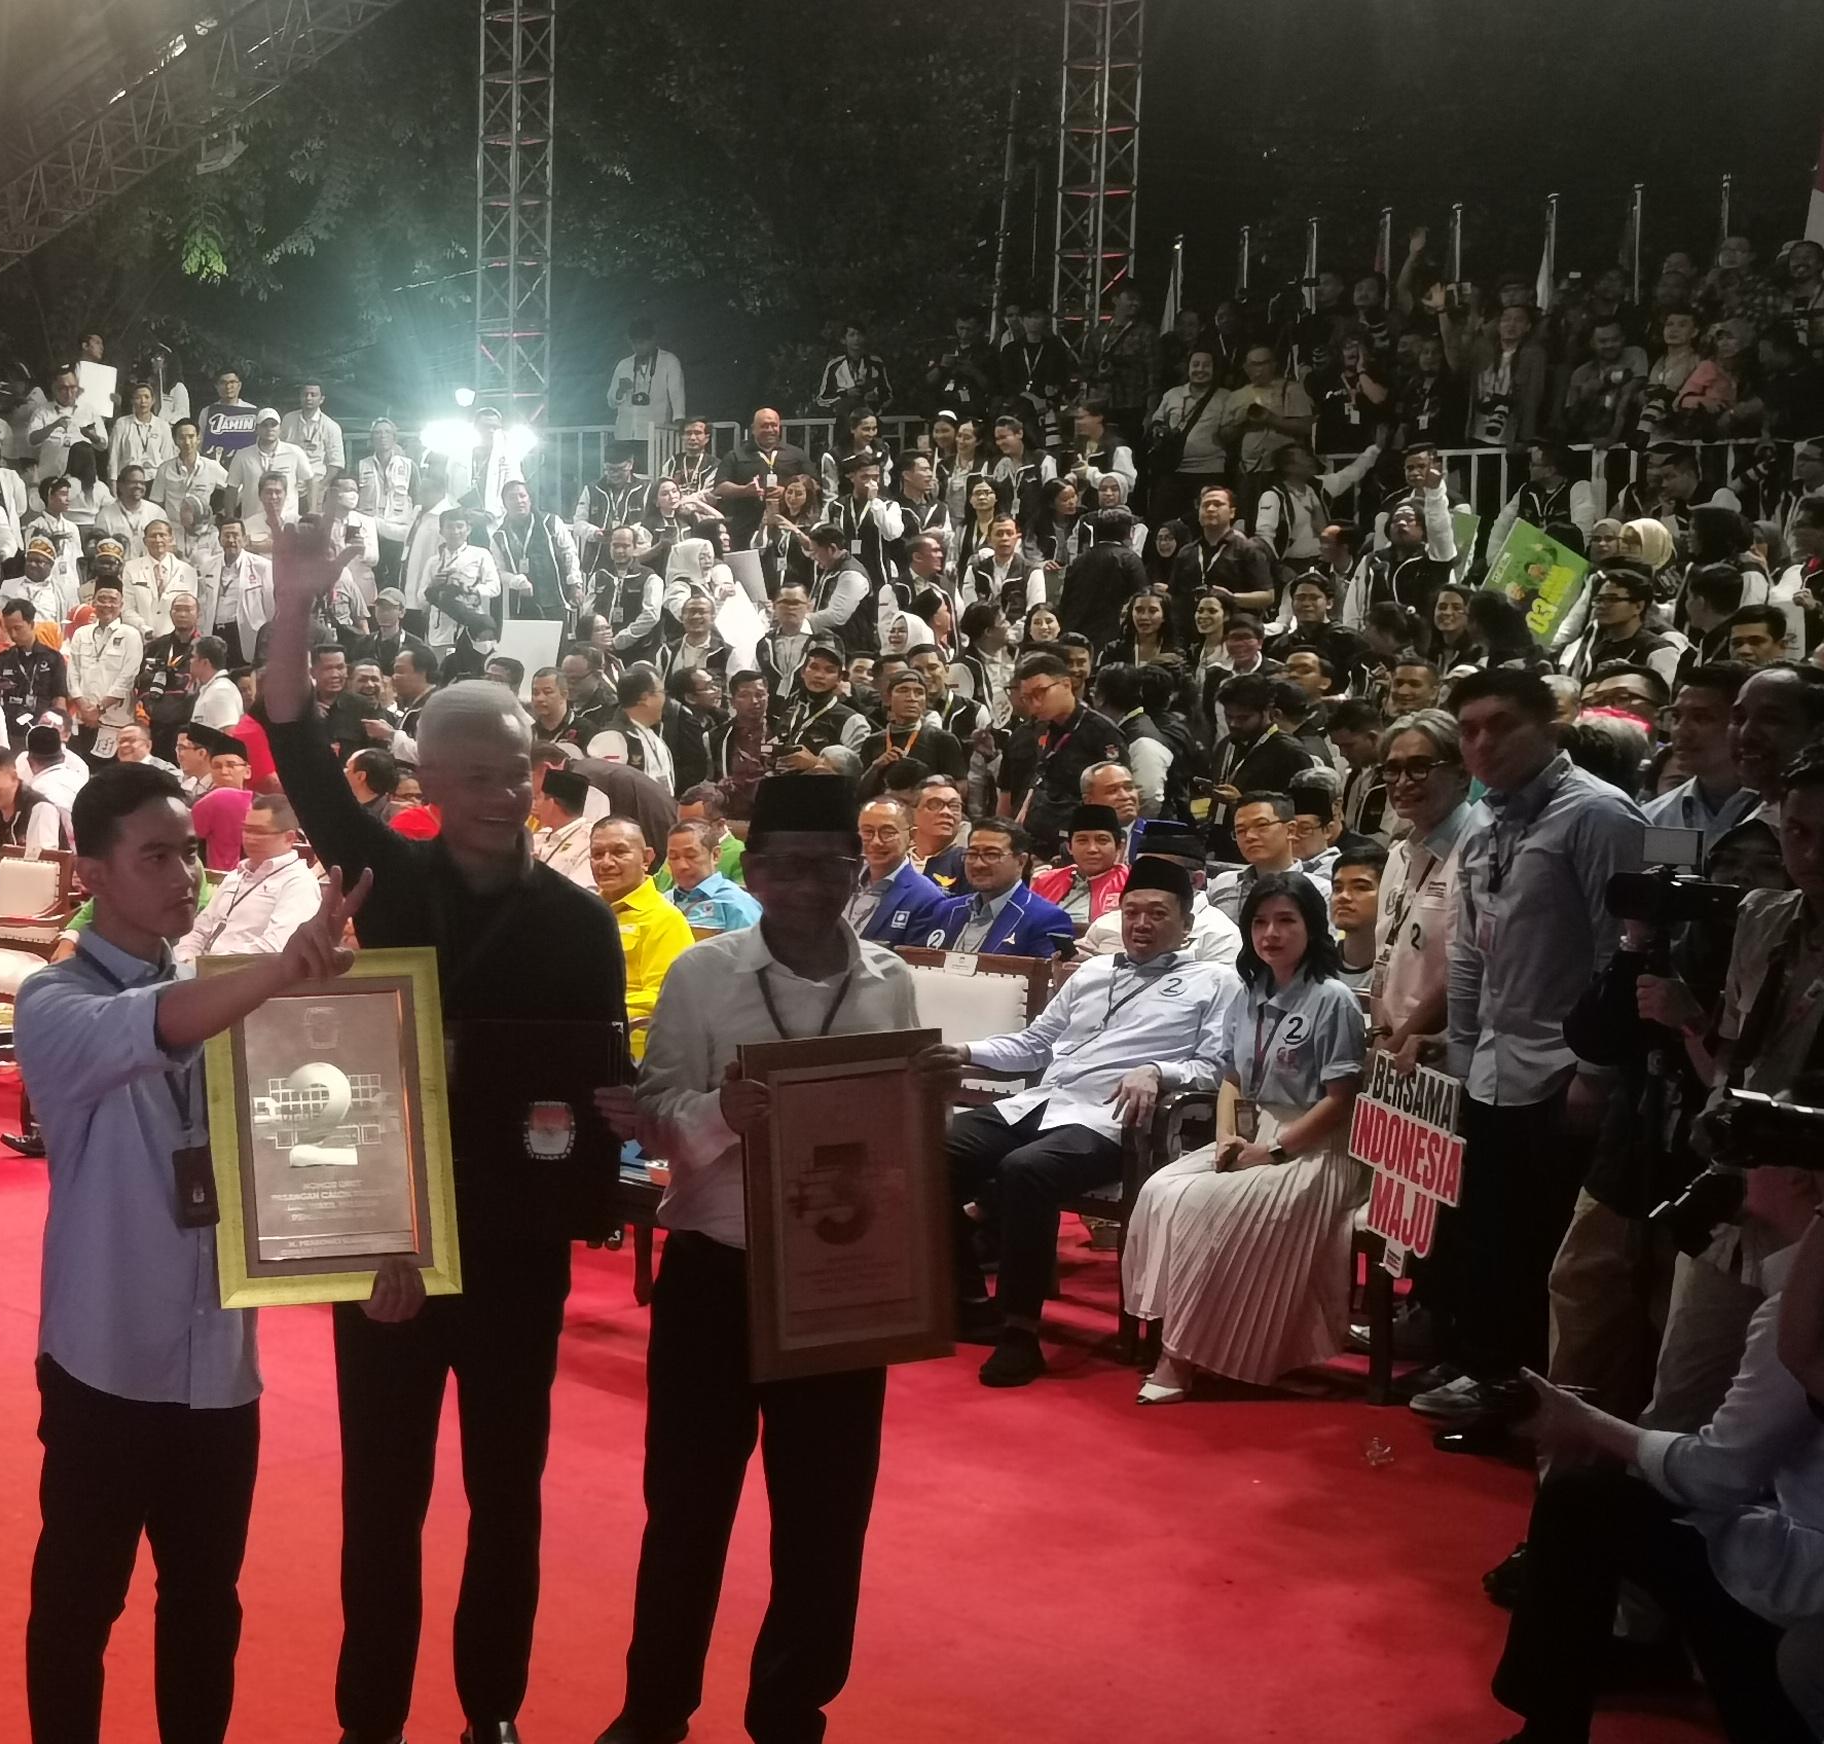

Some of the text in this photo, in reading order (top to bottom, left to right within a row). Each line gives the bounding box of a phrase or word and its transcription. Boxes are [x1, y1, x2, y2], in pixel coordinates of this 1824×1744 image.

[928, 931, 943, 948] 2
[1162, 977, 1184, 994] 2
[1285, 1016, 1305, 1040] 2
[285, 1061, 359, 1168] 2
[1372, 1054, 1457, 1131] BERSAMA
[1350, 1098, 1463, 1202] INDONESIA
[813, 1141, 876, 1247] 3
[1366, 1171, 1436, 1255] MAJU
